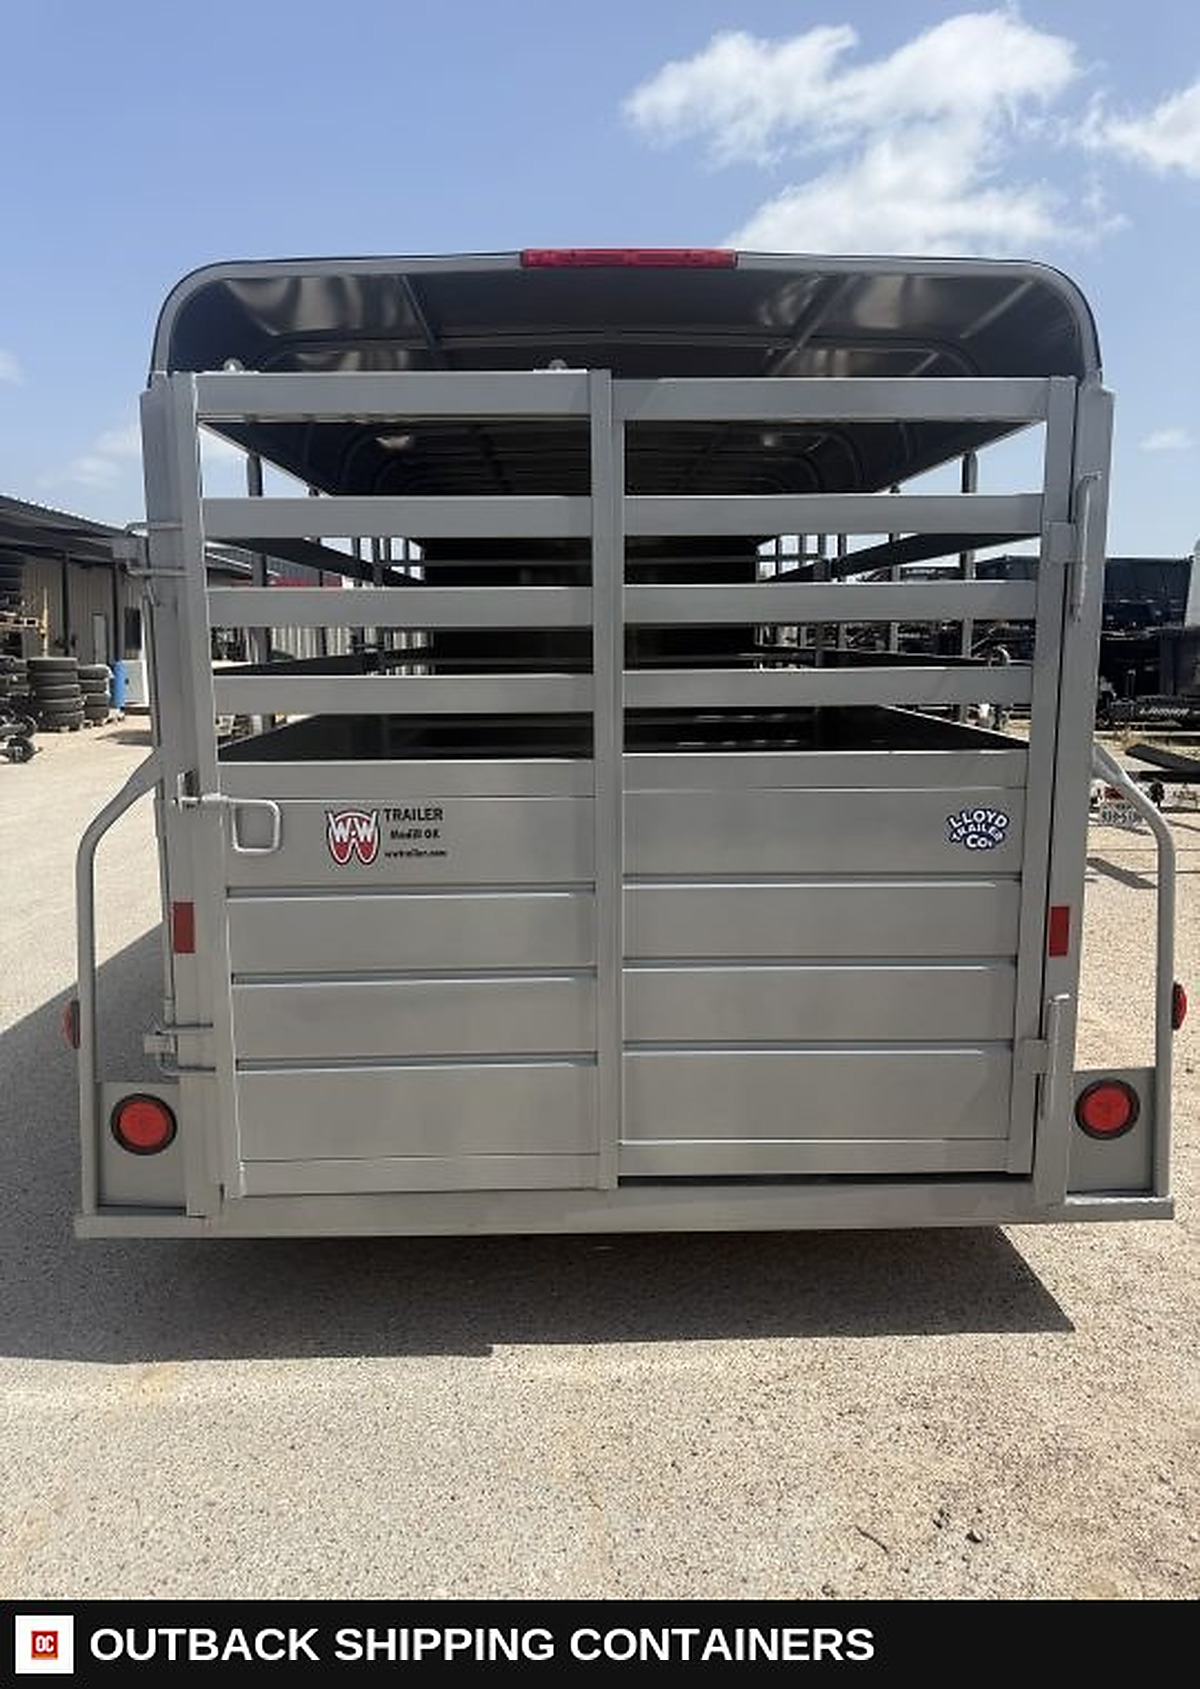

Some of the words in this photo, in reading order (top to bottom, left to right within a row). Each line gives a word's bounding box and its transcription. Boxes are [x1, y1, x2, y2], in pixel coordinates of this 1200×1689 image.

[383, 807, 444, 822] TRAILER
[948, 809, 1008, 829] LLOYD
[950, 823, 1004, 842] TRAILER
[965, 833, 993, 849] Co.
